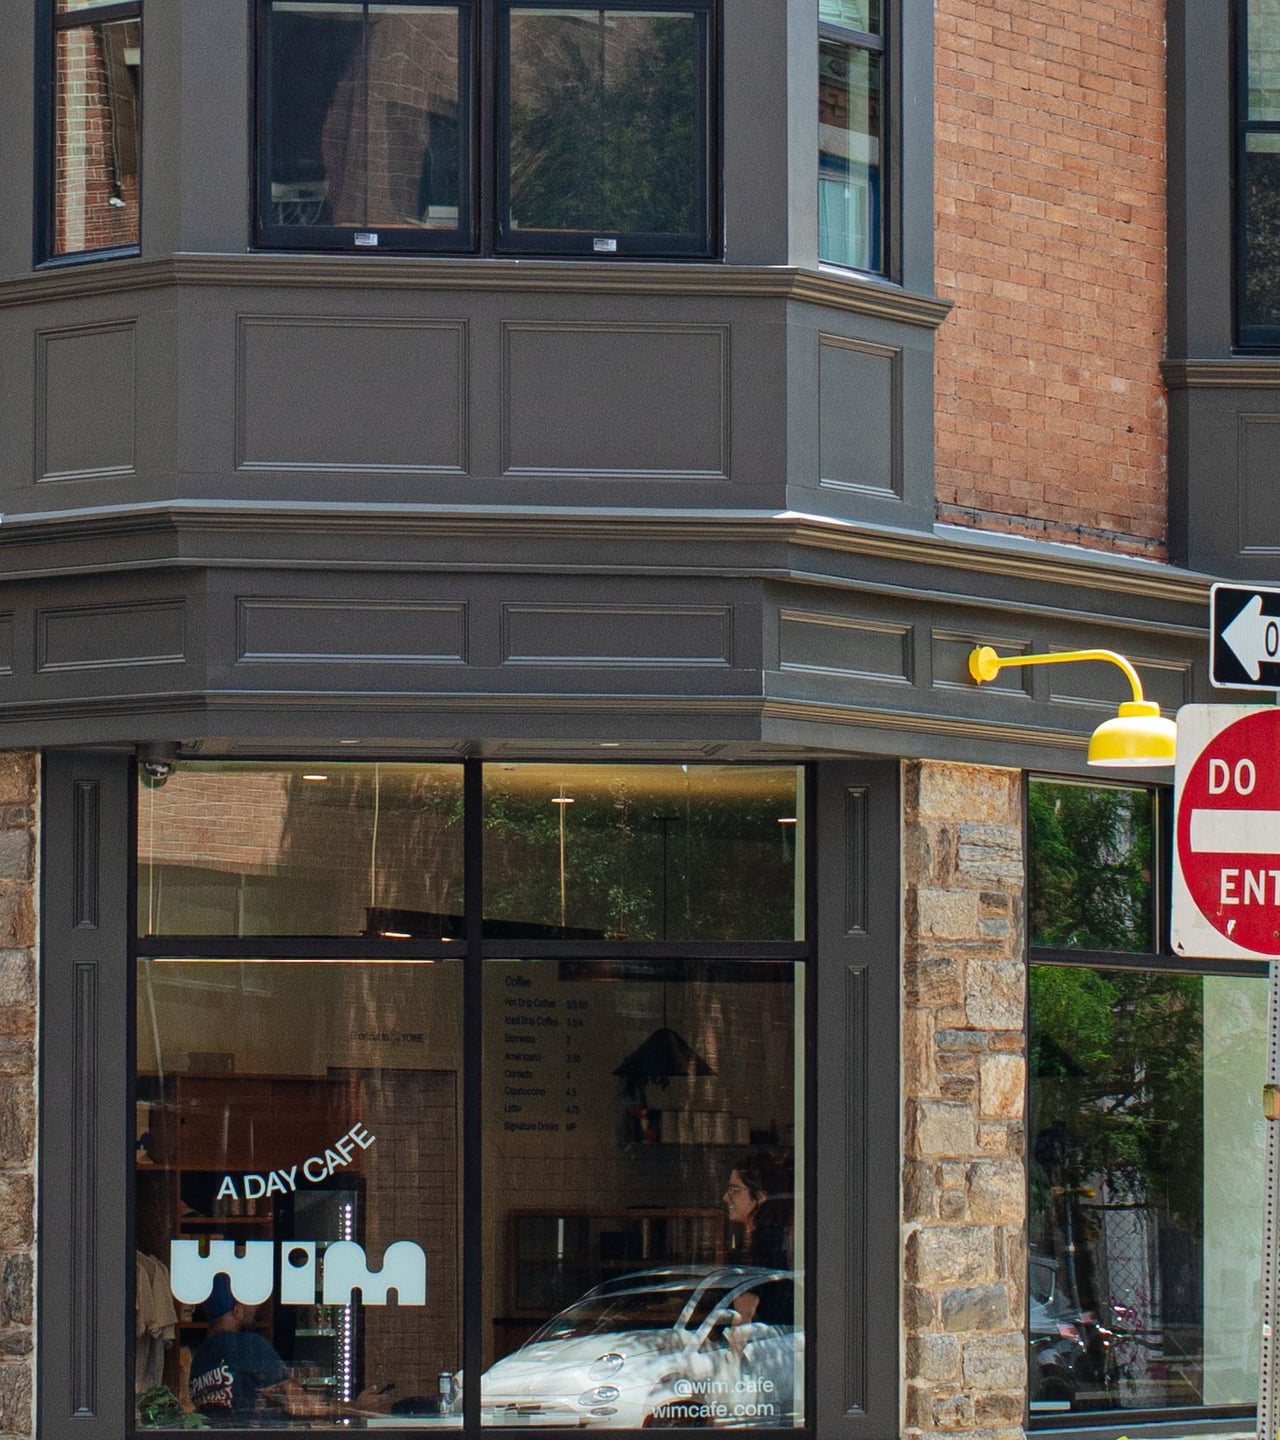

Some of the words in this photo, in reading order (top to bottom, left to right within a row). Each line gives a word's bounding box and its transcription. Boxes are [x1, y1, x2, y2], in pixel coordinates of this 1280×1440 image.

[1208, 758, 1256, 795] DO
[216, 1176, 238, 1200] A
[244, 1165, 298, 1200] DAY
[303, 1122, 376, 1183] CAFE
[673, 1377, 775, 1398] @wim.cafe
[651, 1401, 775, 1419] wimcafe.com
